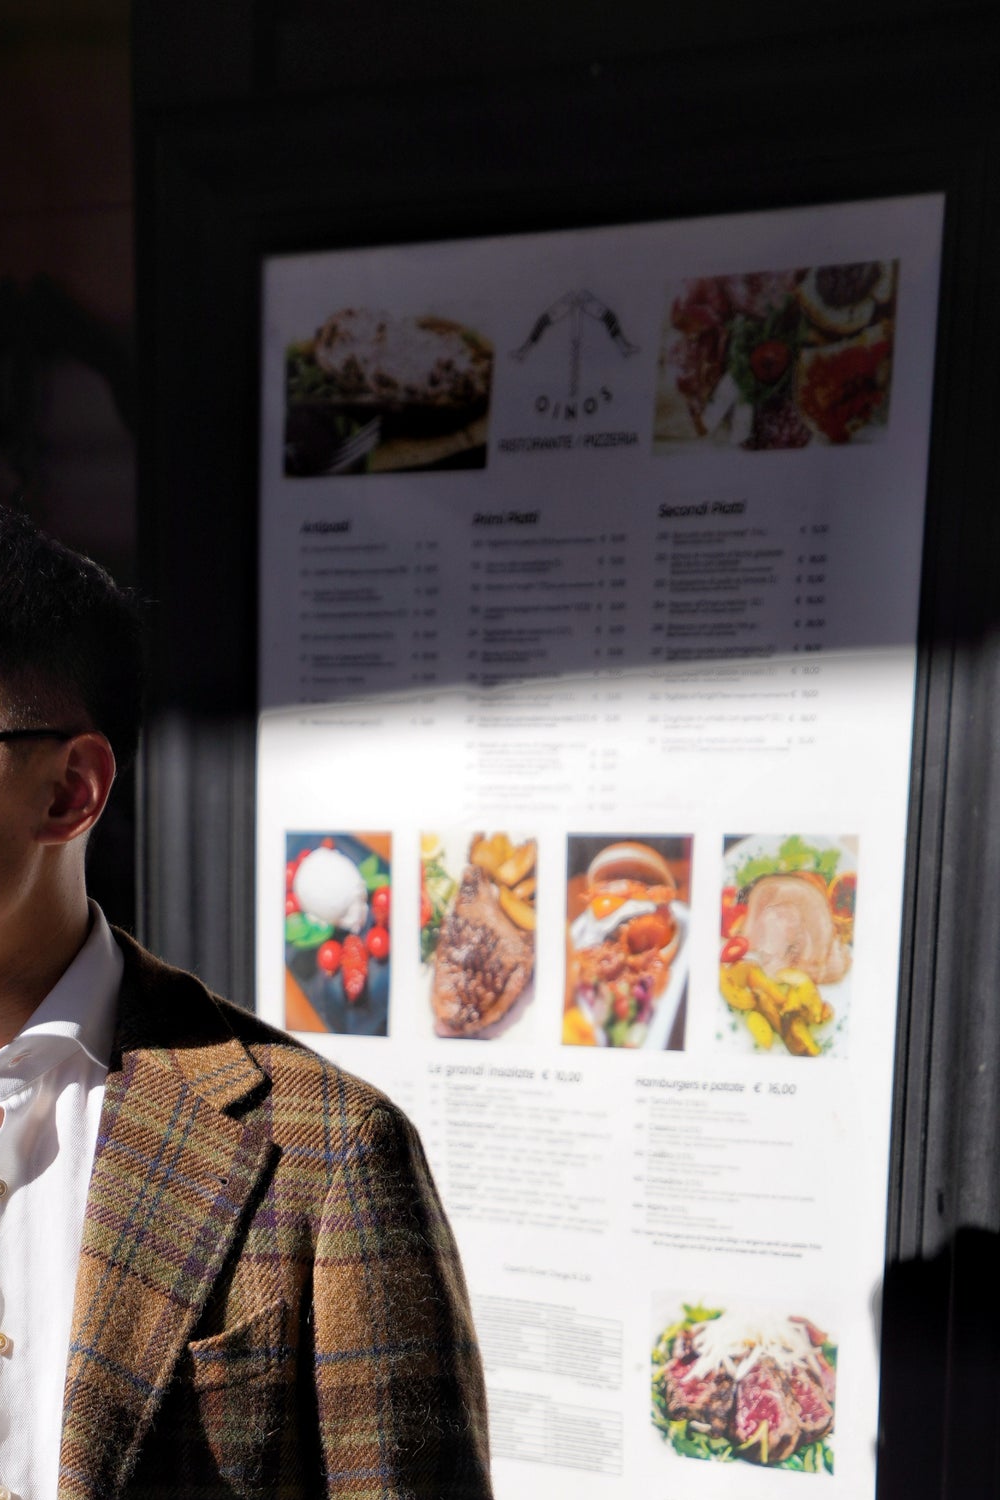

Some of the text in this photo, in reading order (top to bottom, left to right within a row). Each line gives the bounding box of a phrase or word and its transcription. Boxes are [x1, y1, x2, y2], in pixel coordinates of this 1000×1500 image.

[657, 499, 747, 518] Secondi Piatti
[445, 1062, 484, 1078] grandi
[635, 1078, 700, 1092] Hamburgers
